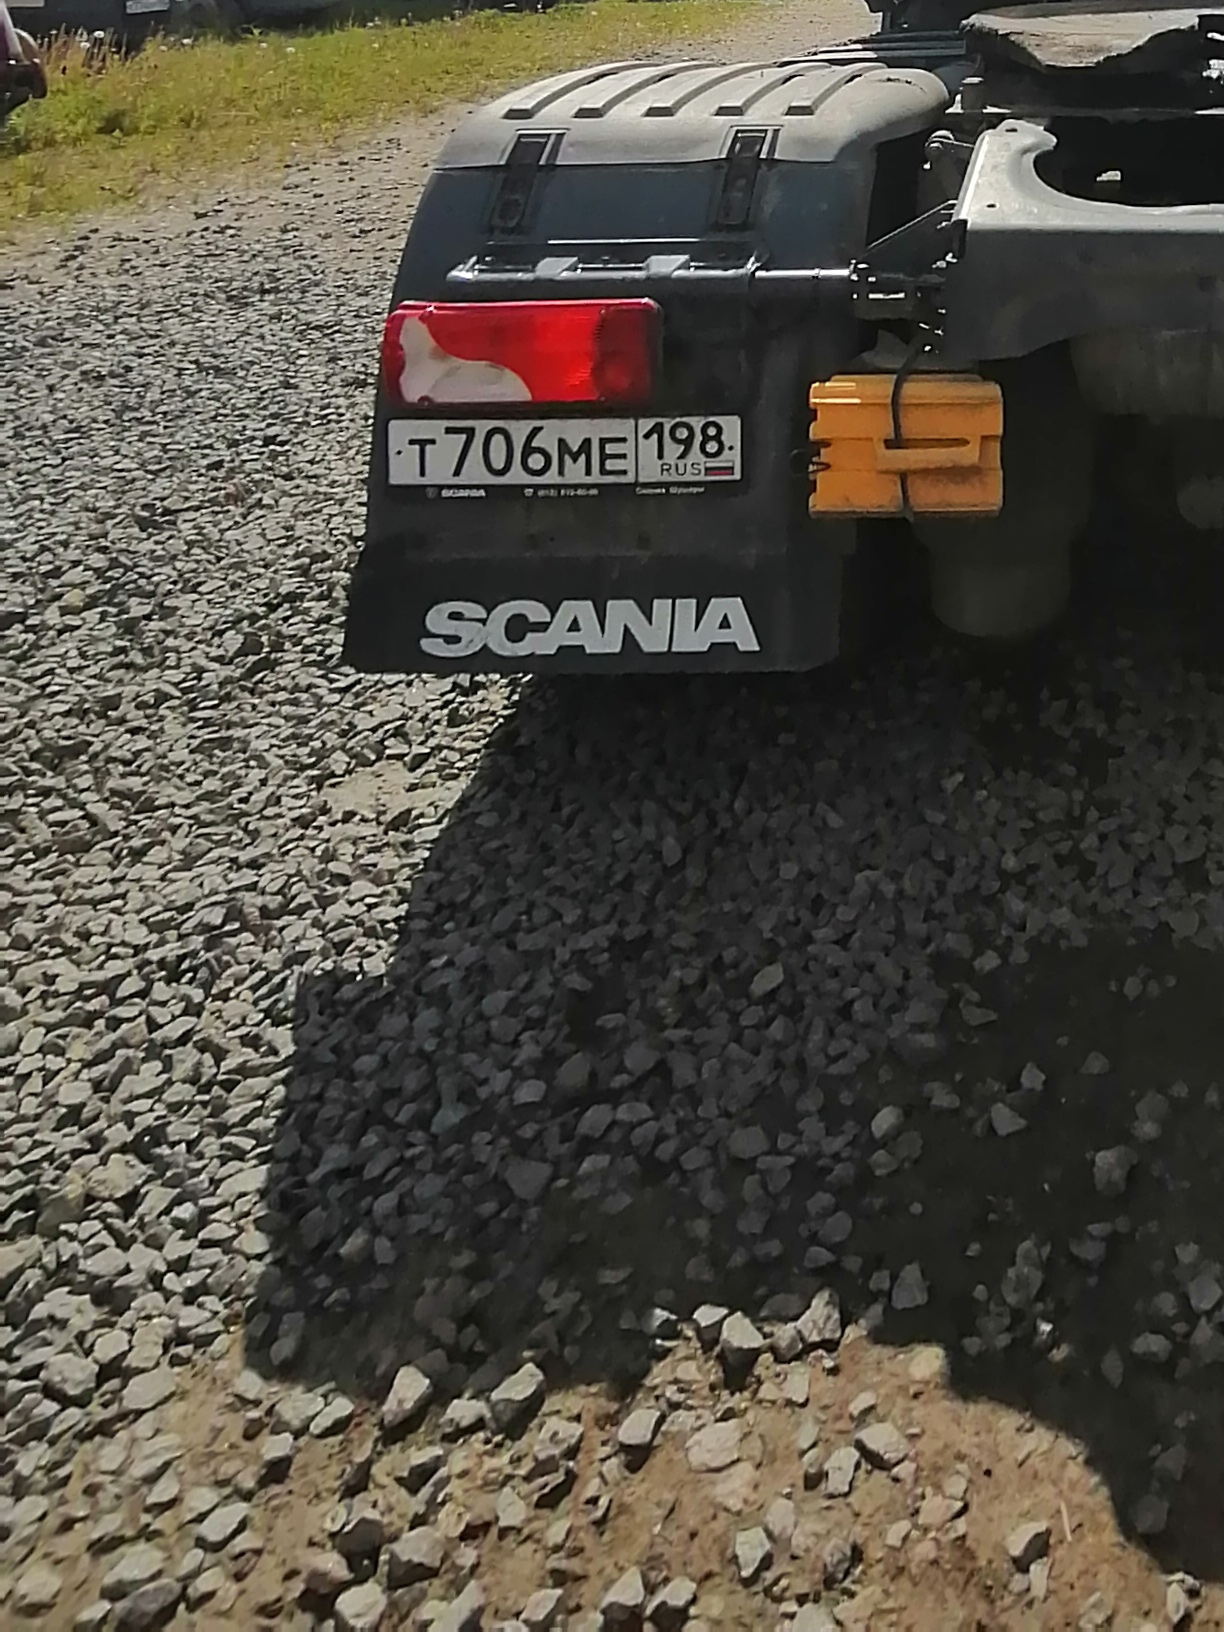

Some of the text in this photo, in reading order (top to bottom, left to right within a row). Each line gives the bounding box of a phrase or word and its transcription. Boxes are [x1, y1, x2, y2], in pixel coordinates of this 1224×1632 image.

[408, 421, 725, 478] Т706МЕ 198
[660, 462, 702, 476] RUS
[419, 596, 761, 659] SCANIA
